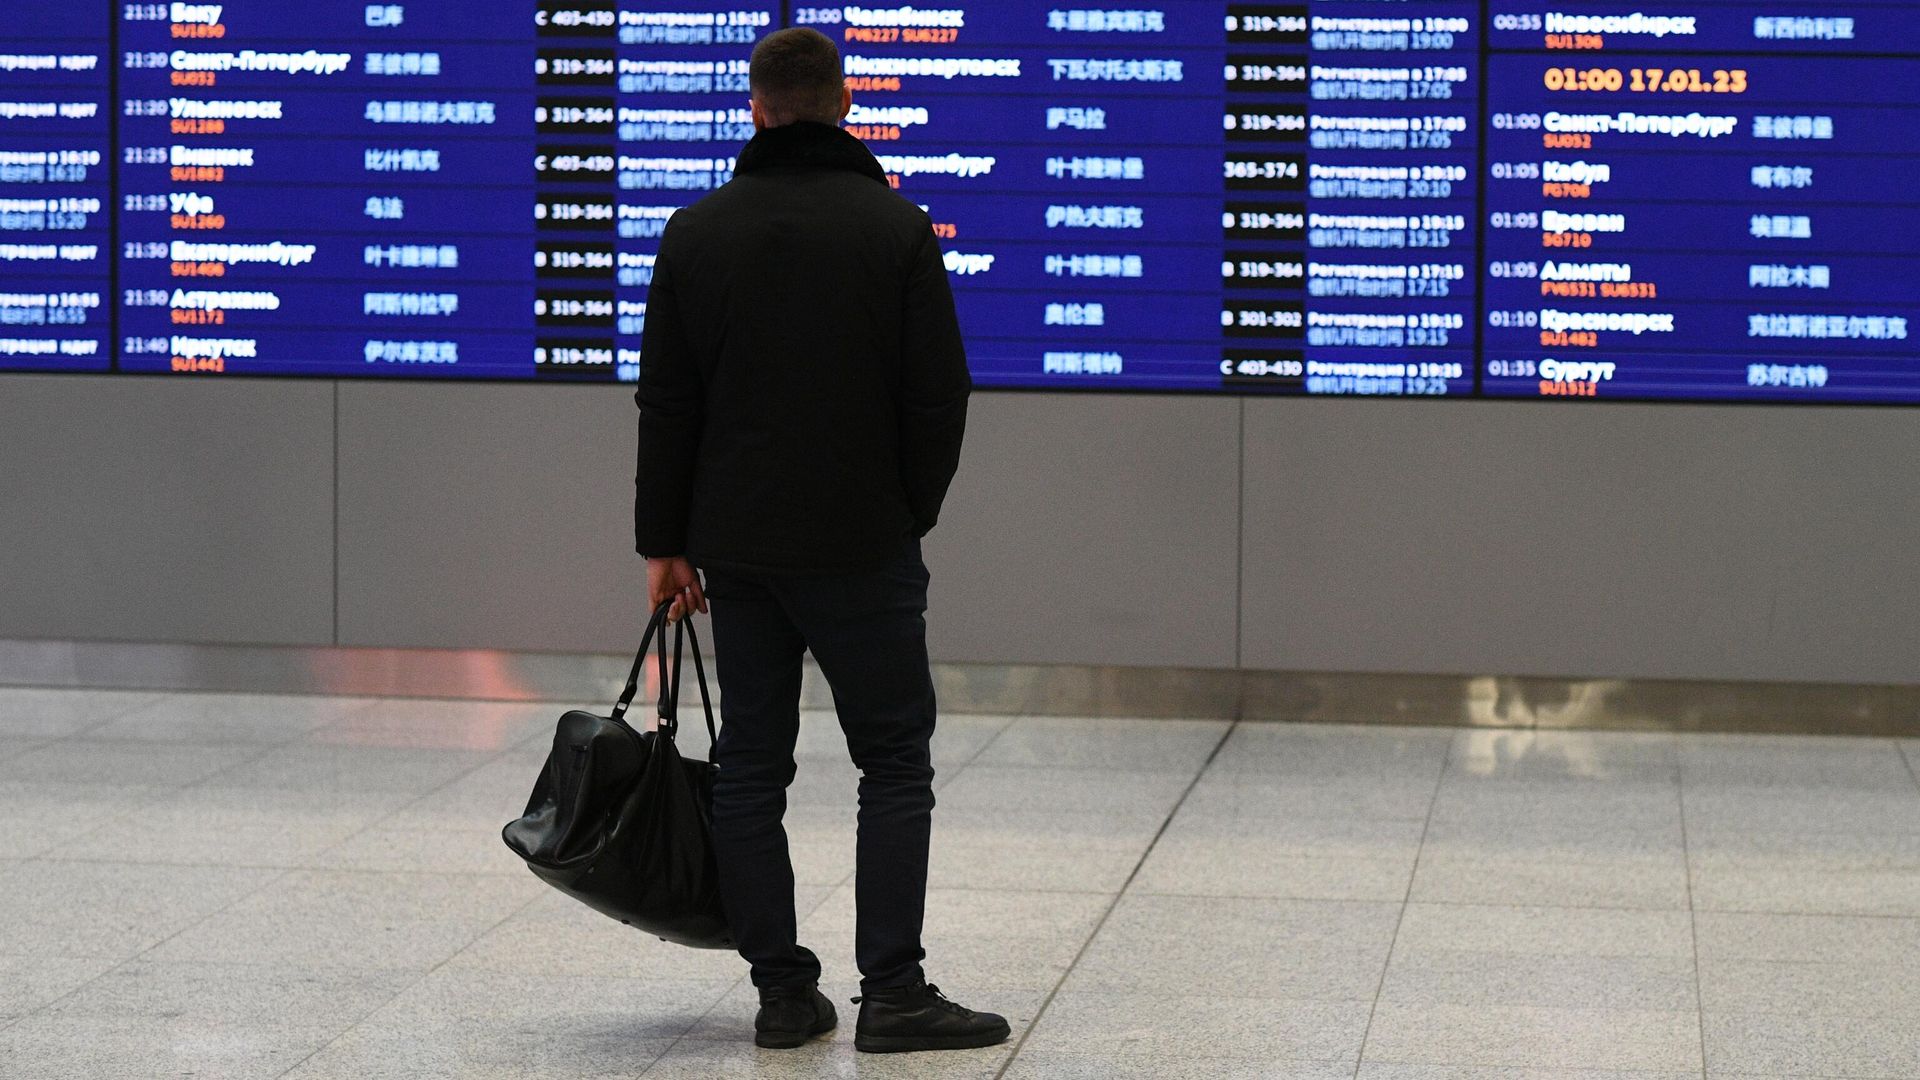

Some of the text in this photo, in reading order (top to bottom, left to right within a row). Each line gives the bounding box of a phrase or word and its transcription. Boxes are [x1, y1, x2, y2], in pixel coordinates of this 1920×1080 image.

[534, 10, 548, 26] C
[1545, 12, 1696, 37] Новосибирск
[714, 75, 750, 92] 15:2
[1544, 68, 1747, 93] 01:00 17.01.23
[1492, 113, 1541, 129] 01:00
[534, 155, 548, 172] C
[874, 152, 996, 177] теринбург
[1223, 161, 1298, 178] 365-374
[1542, 160, 1610, 185] Кабул
[1408, 180, 1451, 198] 20:10
[1540, 260, 1631, 282] Алматы
[1407, 278, 1450, 296] 17:15
[1488, 310, 1538, 327] 01:10
[1540, 308, 1674, 335] Красноярск
[1220, 360, 1233, 375] C
[1538, 358, 1616, 383] Сургут
